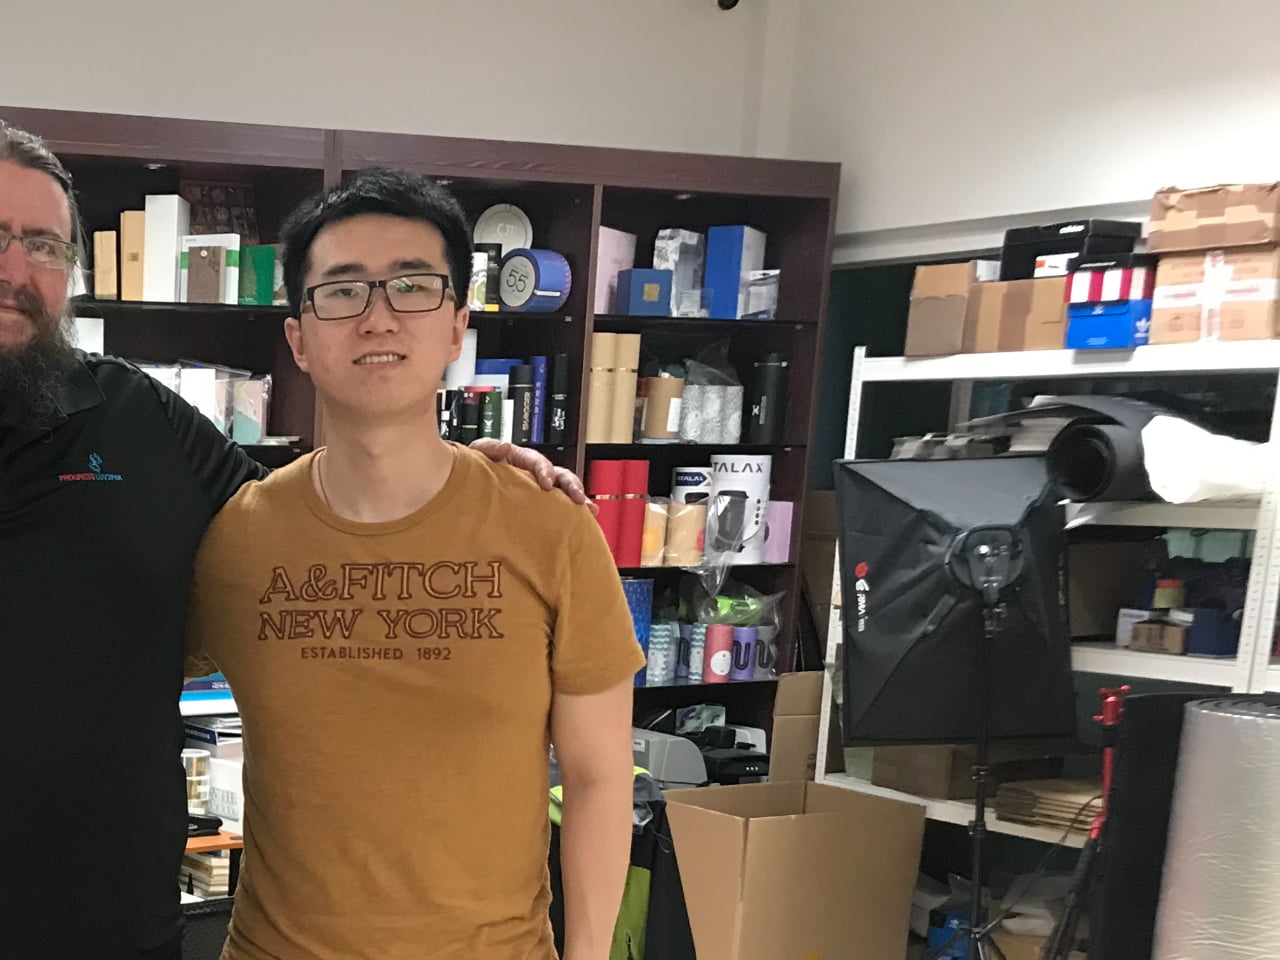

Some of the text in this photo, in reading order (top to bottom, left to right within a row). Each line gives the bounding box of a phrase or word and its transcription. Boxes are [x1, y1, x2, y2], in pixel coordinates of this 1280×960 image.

[506, 269, 529, 293] 55
[259, 561, 503, 604] A&FITCH
[258, 608, 504, 640] NEW YORK
[301, 646, 452, 660] ESTABLISHED 1892
